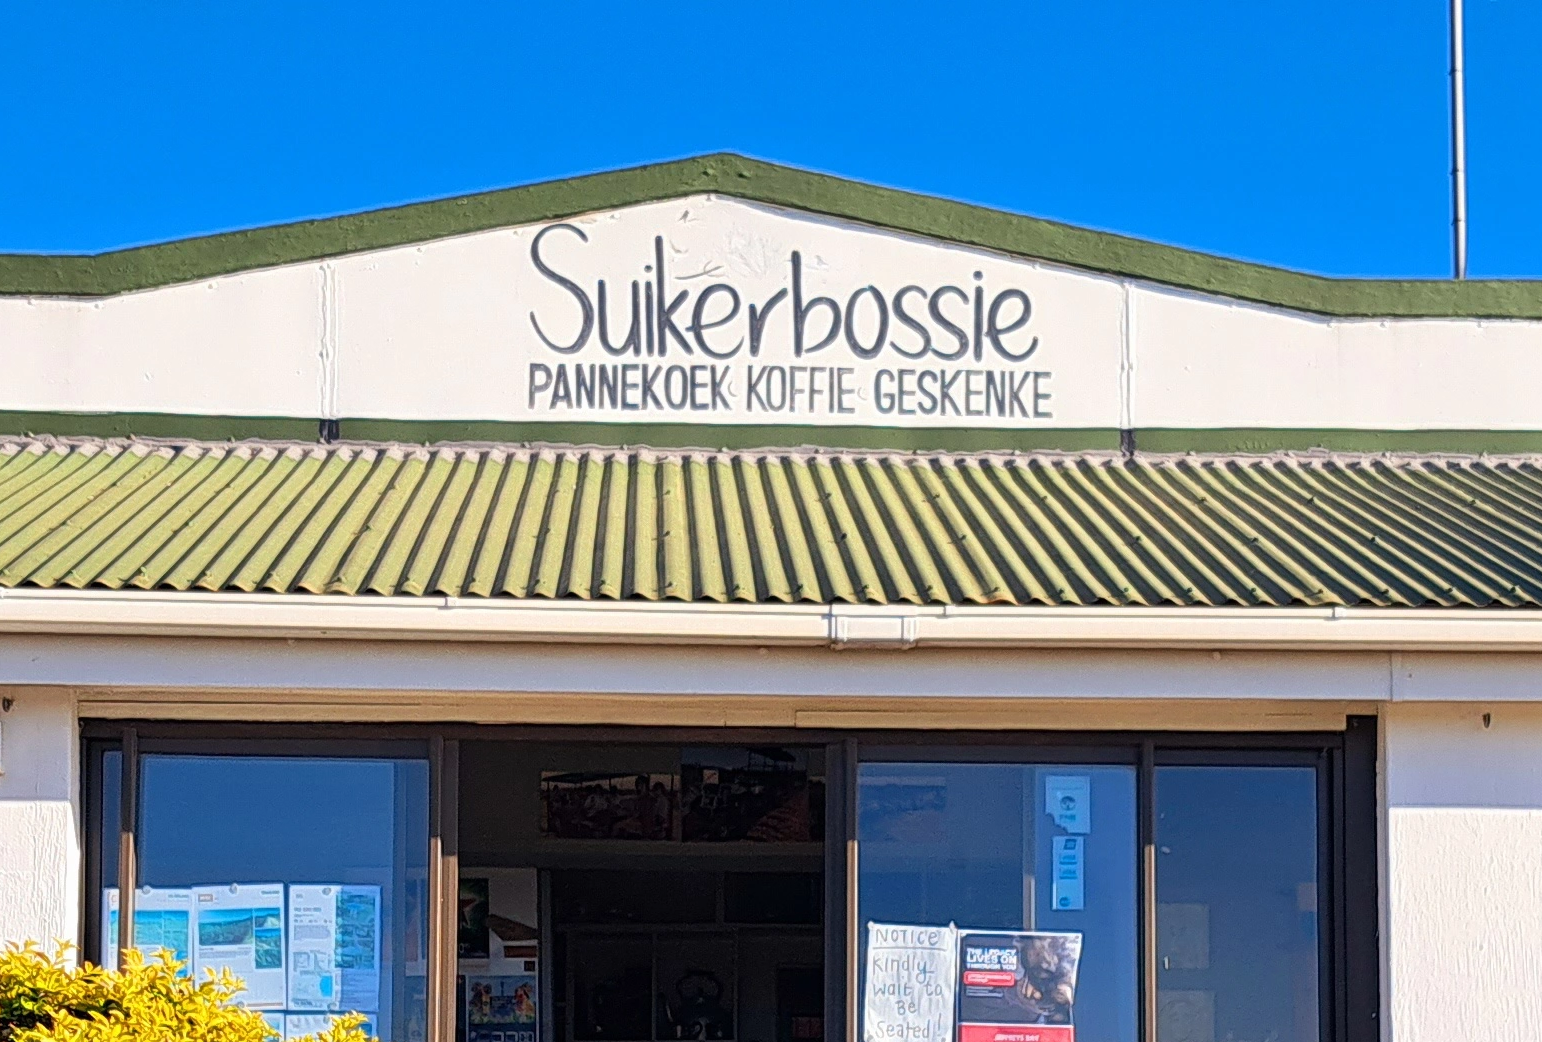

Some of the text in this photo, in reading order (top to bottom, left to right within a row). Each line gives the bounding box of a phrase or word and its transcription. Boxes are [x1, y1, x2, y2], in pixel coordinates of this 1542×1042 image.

[529, 223, 1039, 362] Suikerbossie
[528, 362, 1053, 418] PANNEKOEK KOFFIE GESKENKE
[967, 953, 1017, 963] LIVES ON
[926, 984, 943, 996] to
[896, 1001, 917, 1015] Be
